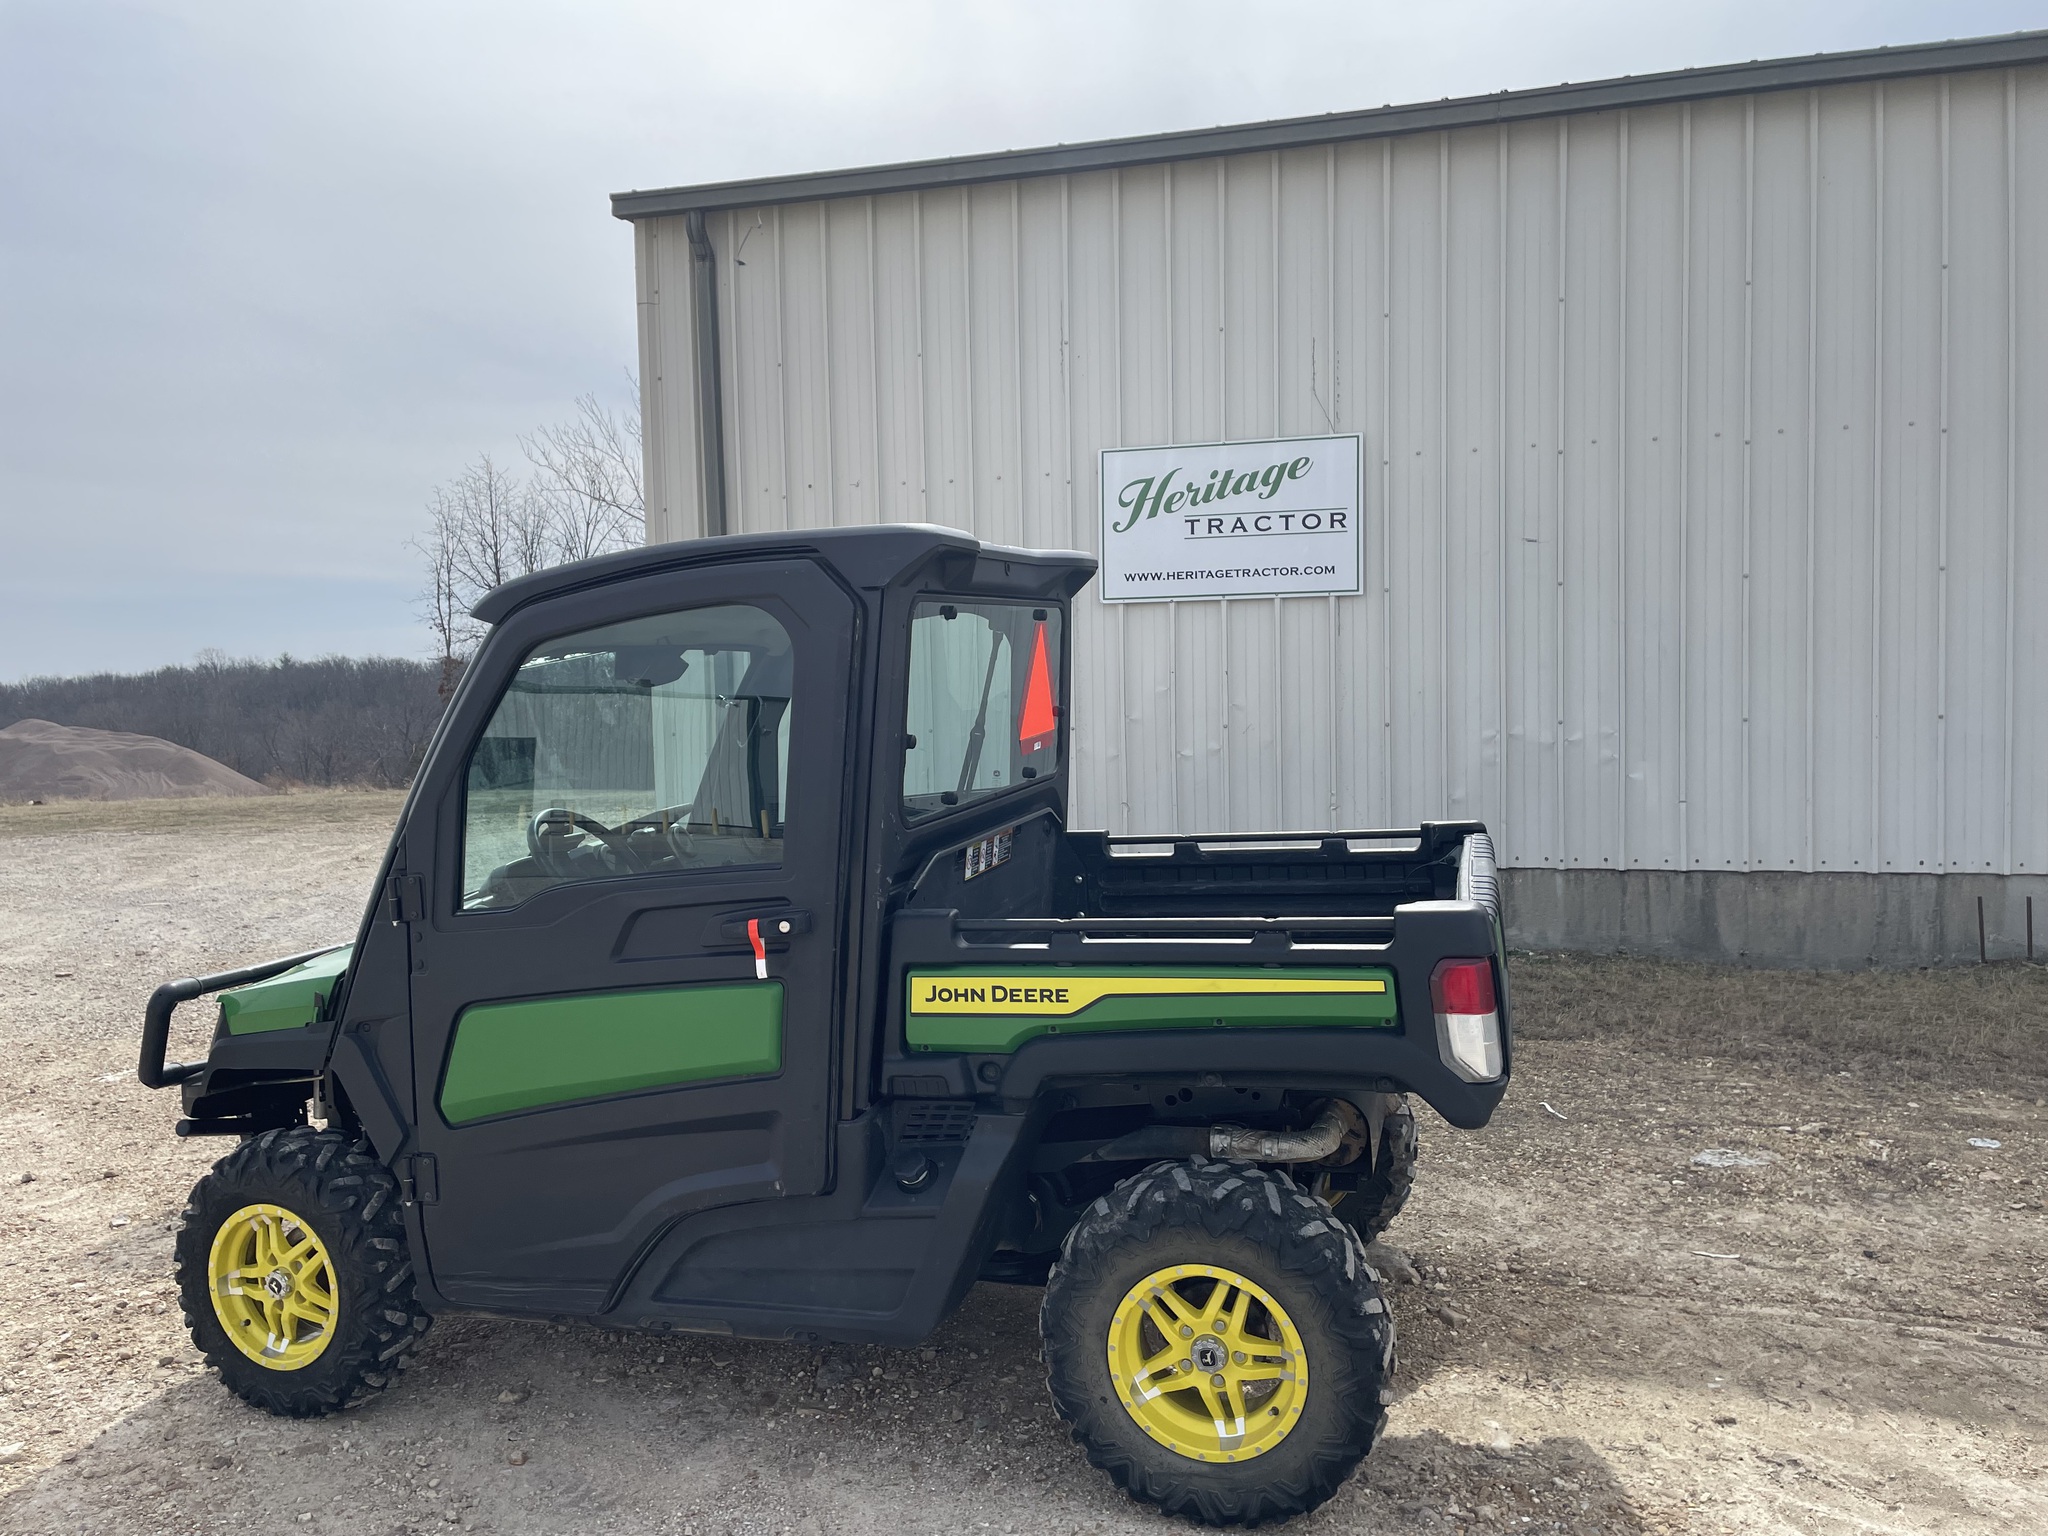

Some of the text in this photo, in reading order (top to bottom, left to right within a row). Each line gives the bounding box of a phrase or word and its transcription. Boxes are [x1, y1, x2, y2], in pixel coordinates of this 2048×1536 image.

[1112, 456, 1314, 533] Heritage
[1184, 512, 1347, 535] TRACTOR
[1124, 565, 1335, 582] WWW.HERITAGETRACTOR.COM
[925, 985, 1069, 1003] JOHN DEERE
